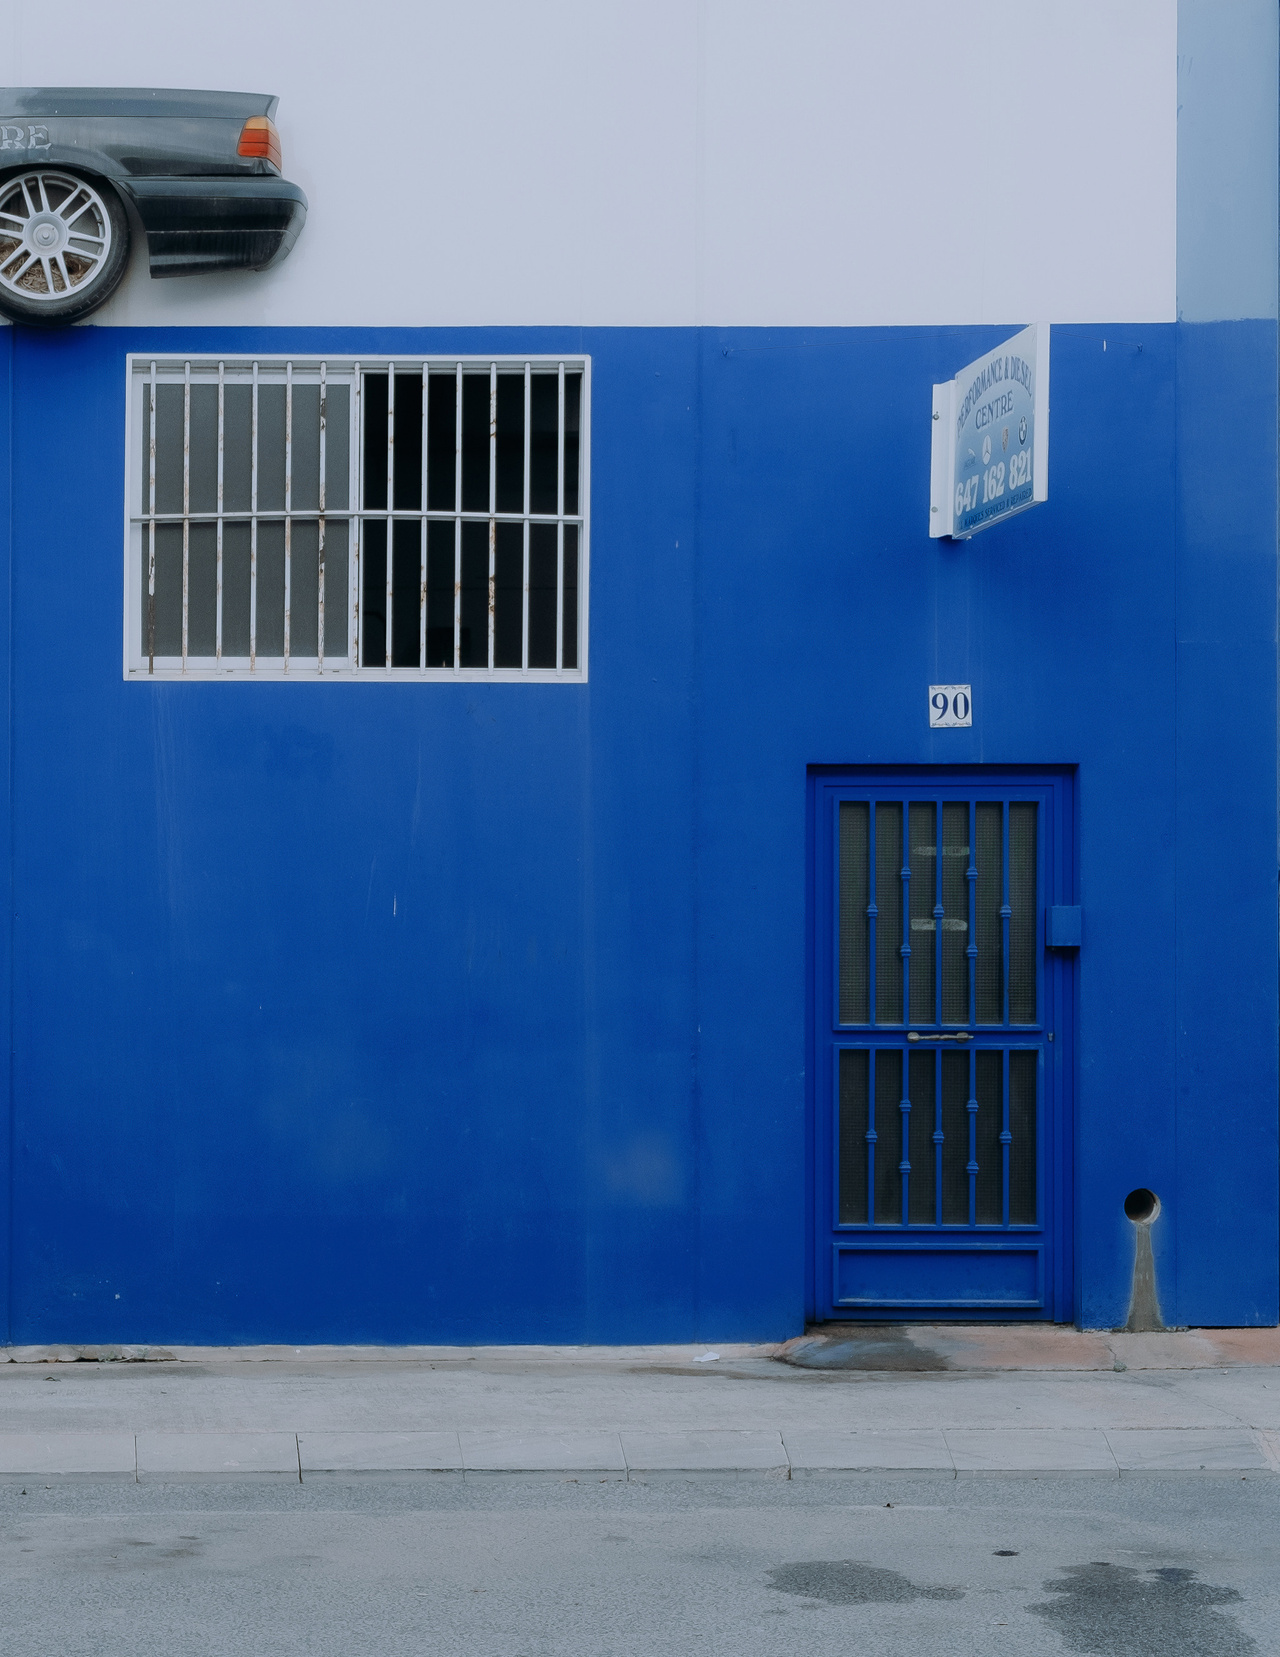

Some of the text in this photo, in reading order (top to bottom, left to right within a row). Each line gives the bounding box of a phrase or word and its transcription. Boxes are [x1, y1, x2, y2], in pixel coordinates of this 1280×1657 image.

[957, 357, 1003, 441] PERFORMANCE
[1010, 355, 1032, 398] DIESEL
[975, 389, 1014, 430] CENTRE
[955, 446, 1032, 517] 647 162 821
[931, 691, 970, 721] 90
